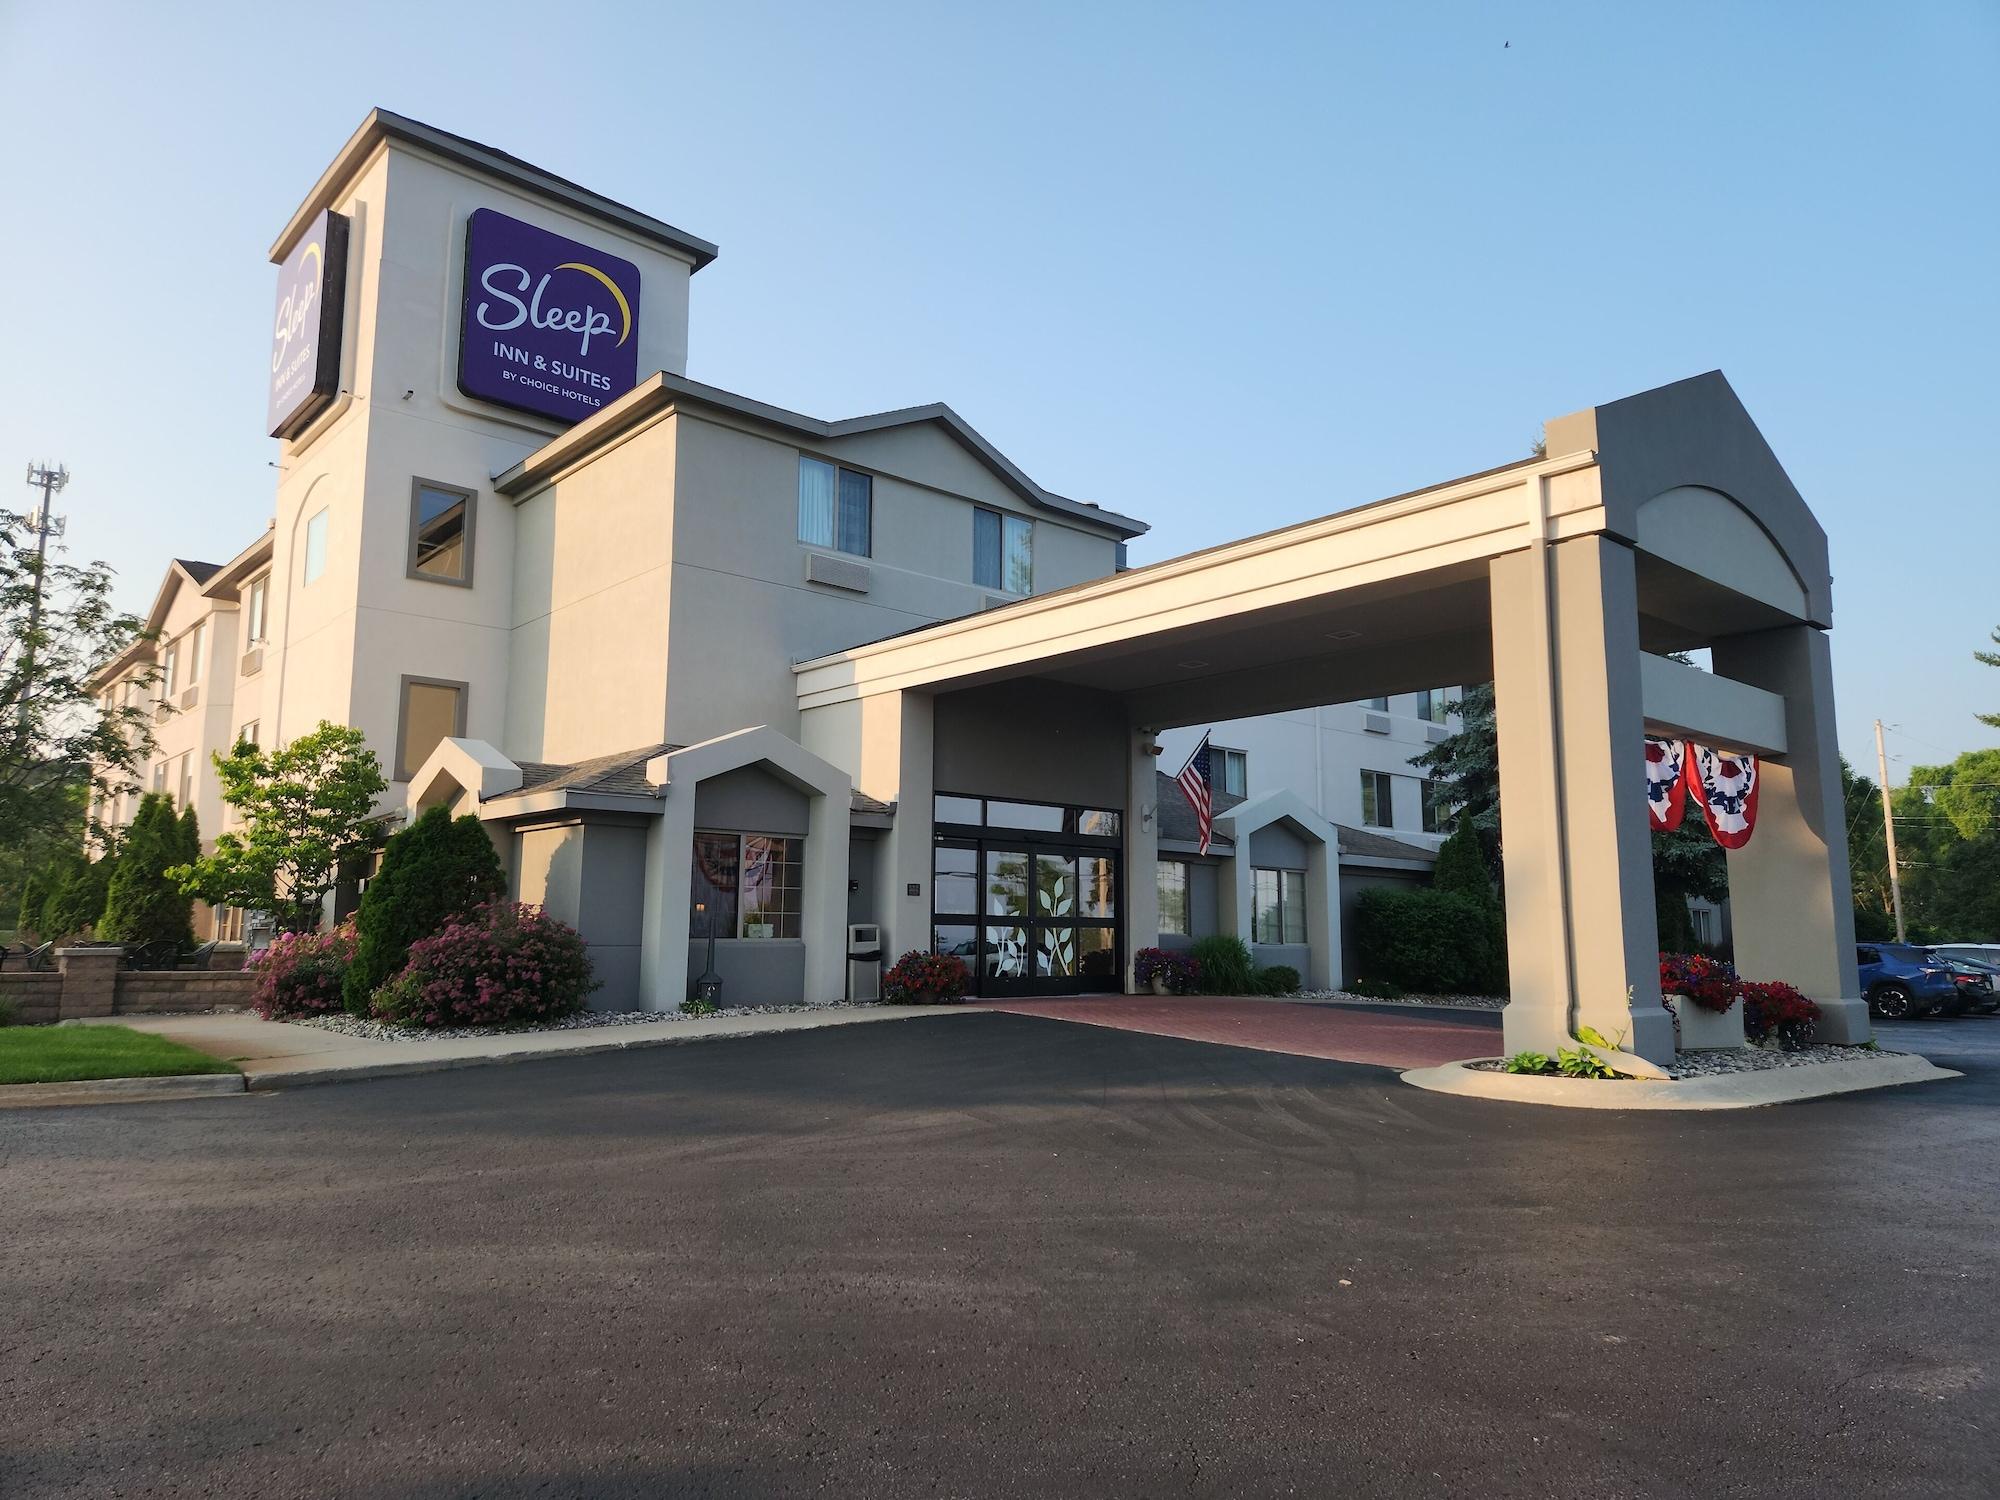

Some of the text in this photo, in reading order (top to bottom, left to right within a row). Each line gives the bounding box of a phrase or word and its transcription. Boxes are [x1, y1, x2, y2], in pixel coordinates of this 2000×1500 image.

[272, 281, 315, 373] Sleep
[476, 263, 617, 356] Sleep
[493, 341, 611, 391] INN & SUITES
[502, 370, 601, 407] BY CHOICE HOTELS
